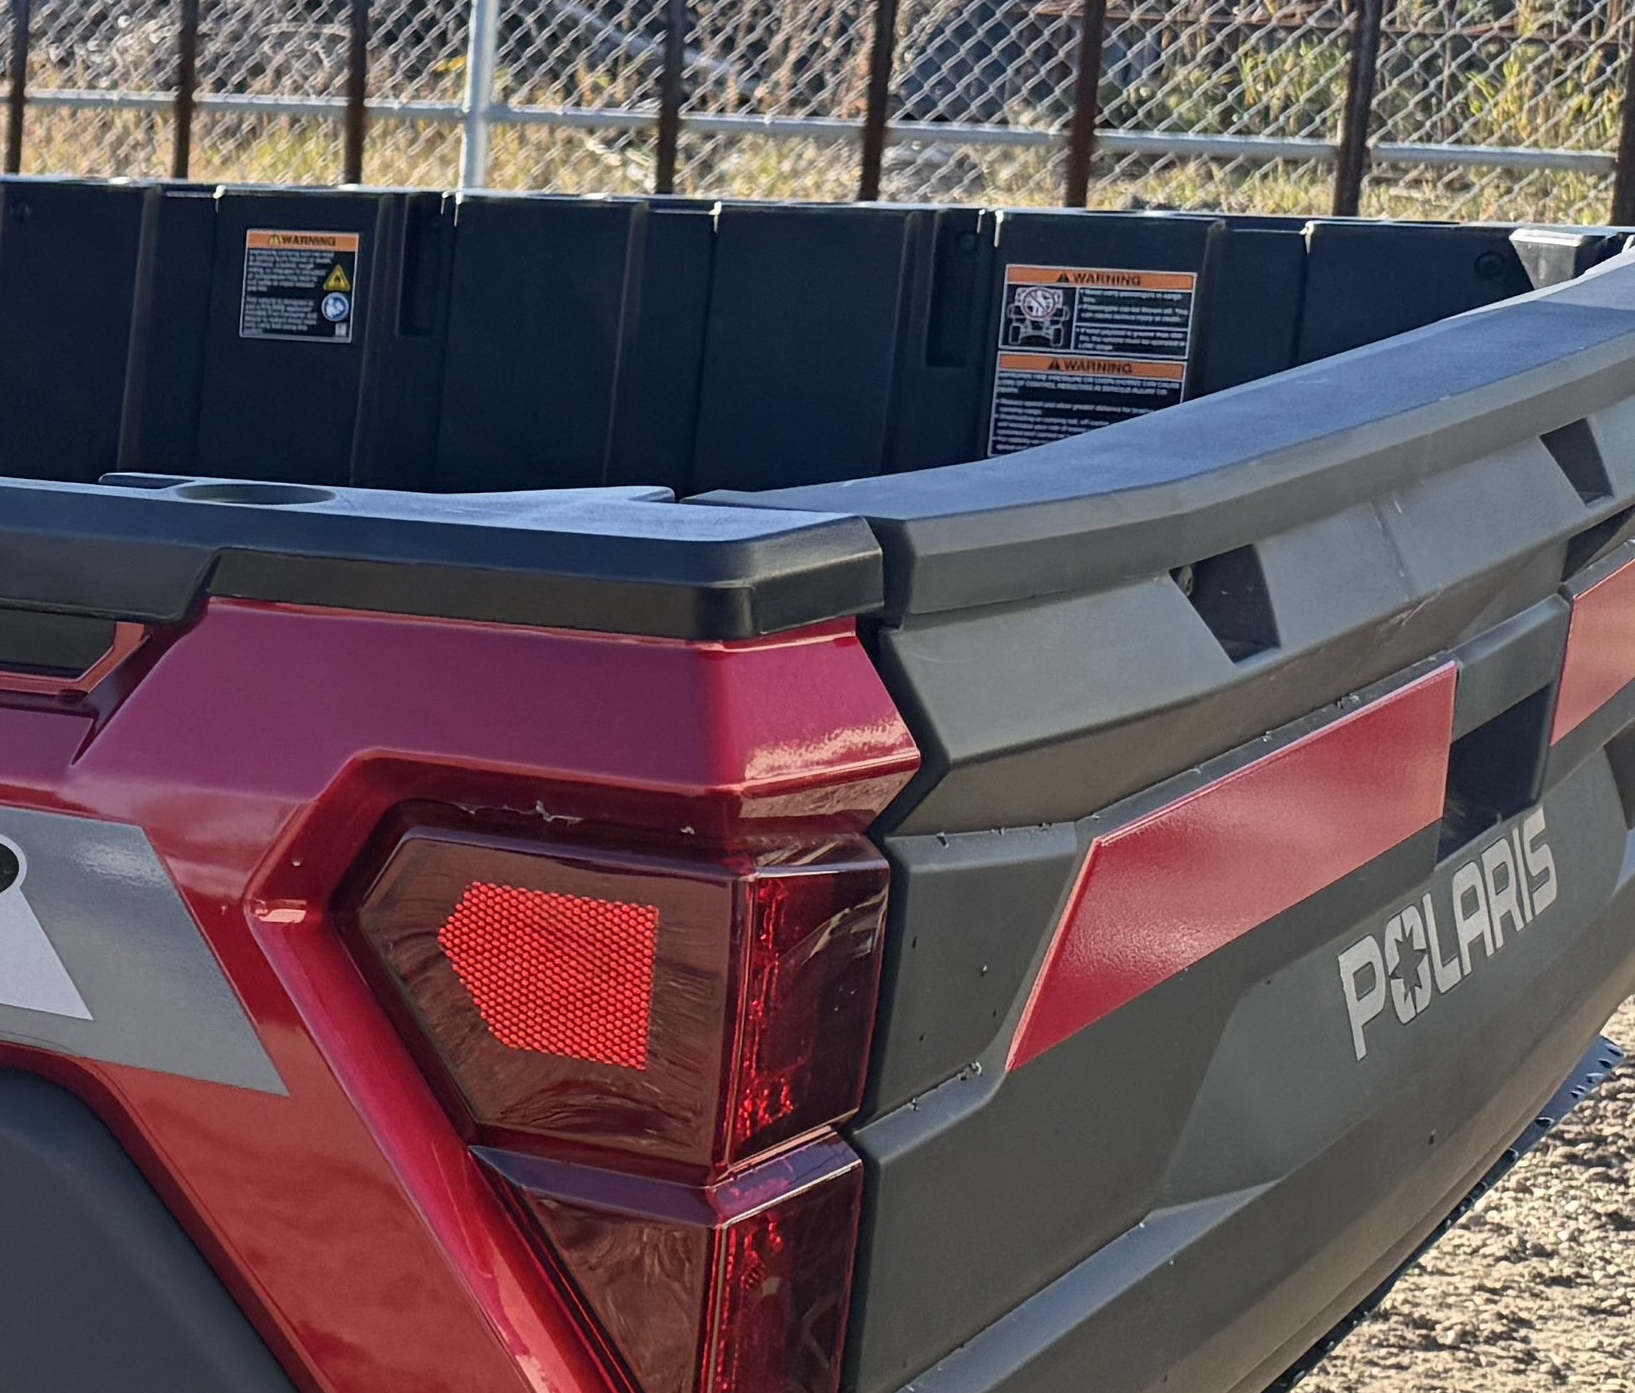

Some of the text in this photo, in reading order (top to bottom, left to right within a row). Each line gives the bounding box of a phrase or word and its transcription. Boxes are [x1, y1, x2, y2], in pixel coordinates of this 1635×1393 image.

[282, 235, 336, 246] WARNING
[1073, 272, 1141, 286] WARNING
[1064, 360, 1133, 374] WARNING
[1338, 807, 1558, 1061] POLARIS
